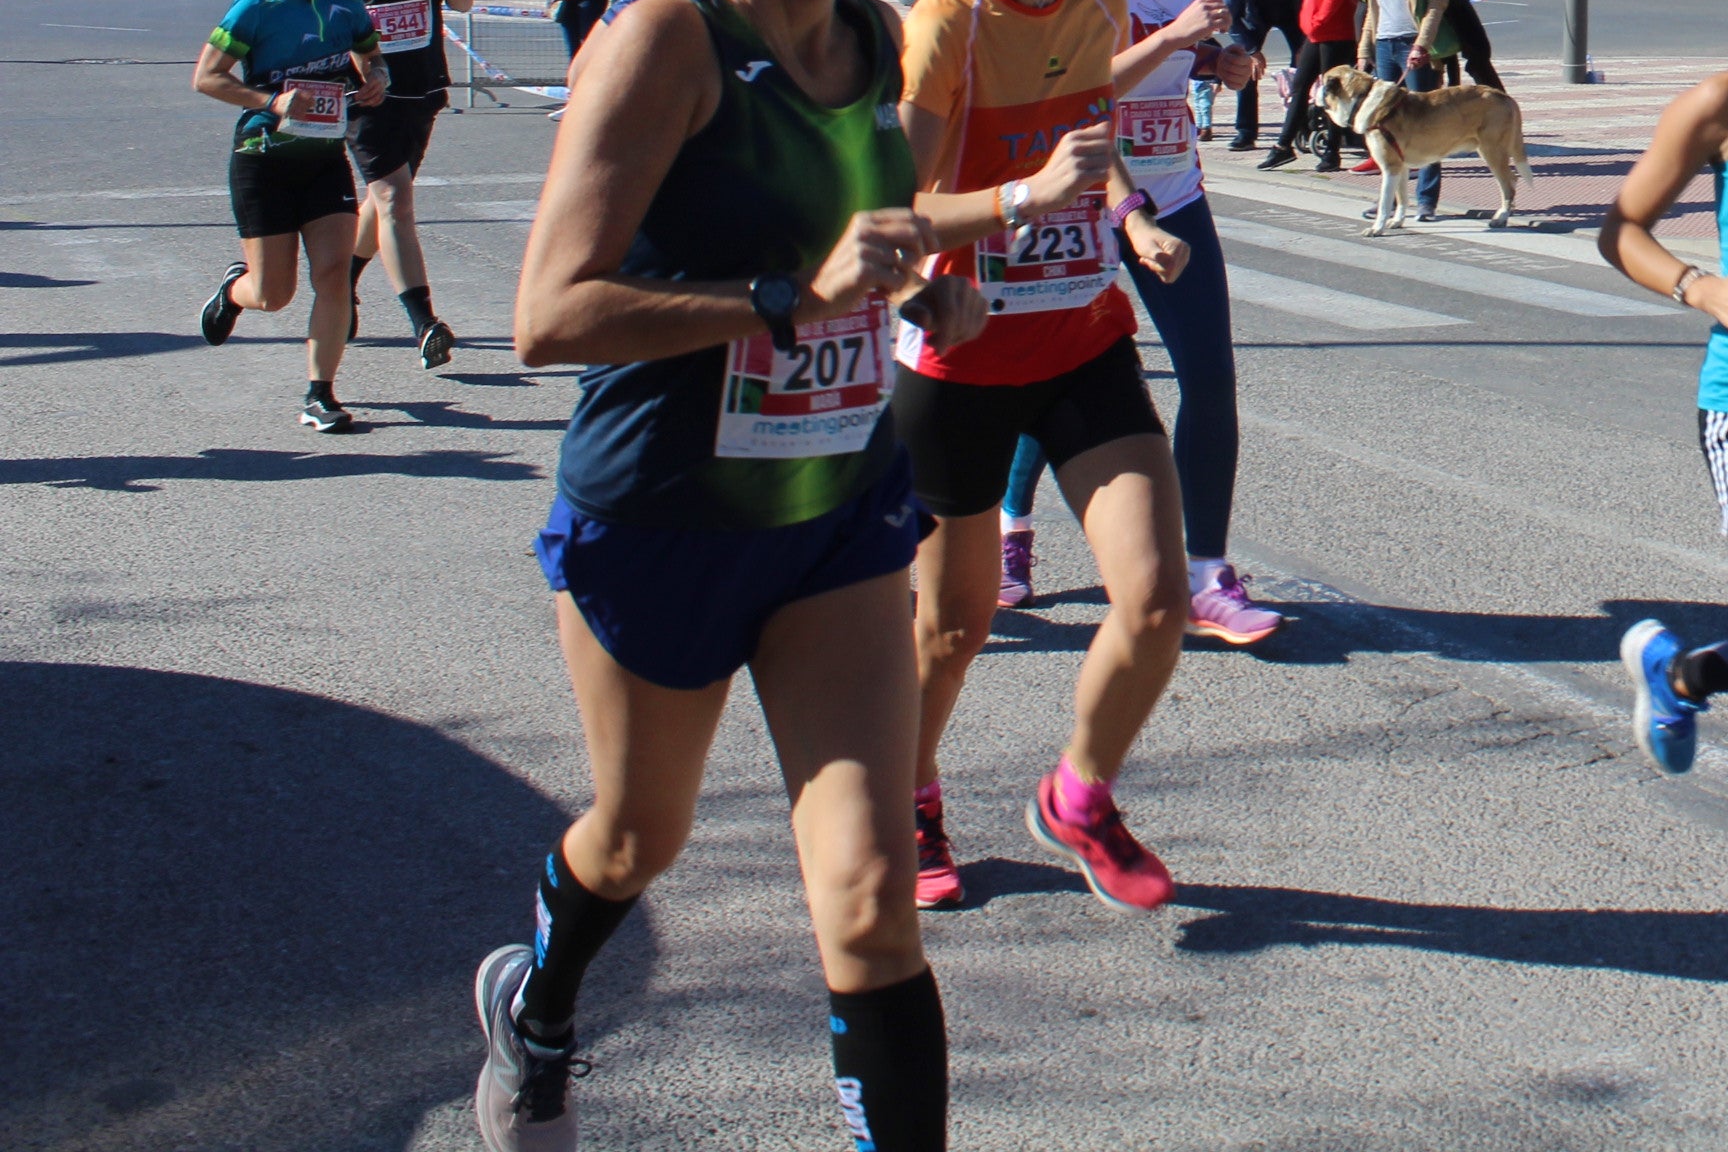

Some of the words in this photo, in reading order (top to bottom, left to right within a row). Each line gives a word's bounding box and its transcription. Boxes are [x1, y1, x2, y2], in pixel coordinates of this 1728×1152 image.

[385, 13, 419, 33] 544
[1141, 117, 1184, 144] 571
[1017, 225, 1086, 264] 223
[1001, 276, 1106, 298] meetingpoint
[783, 335, 865, 392] 207
